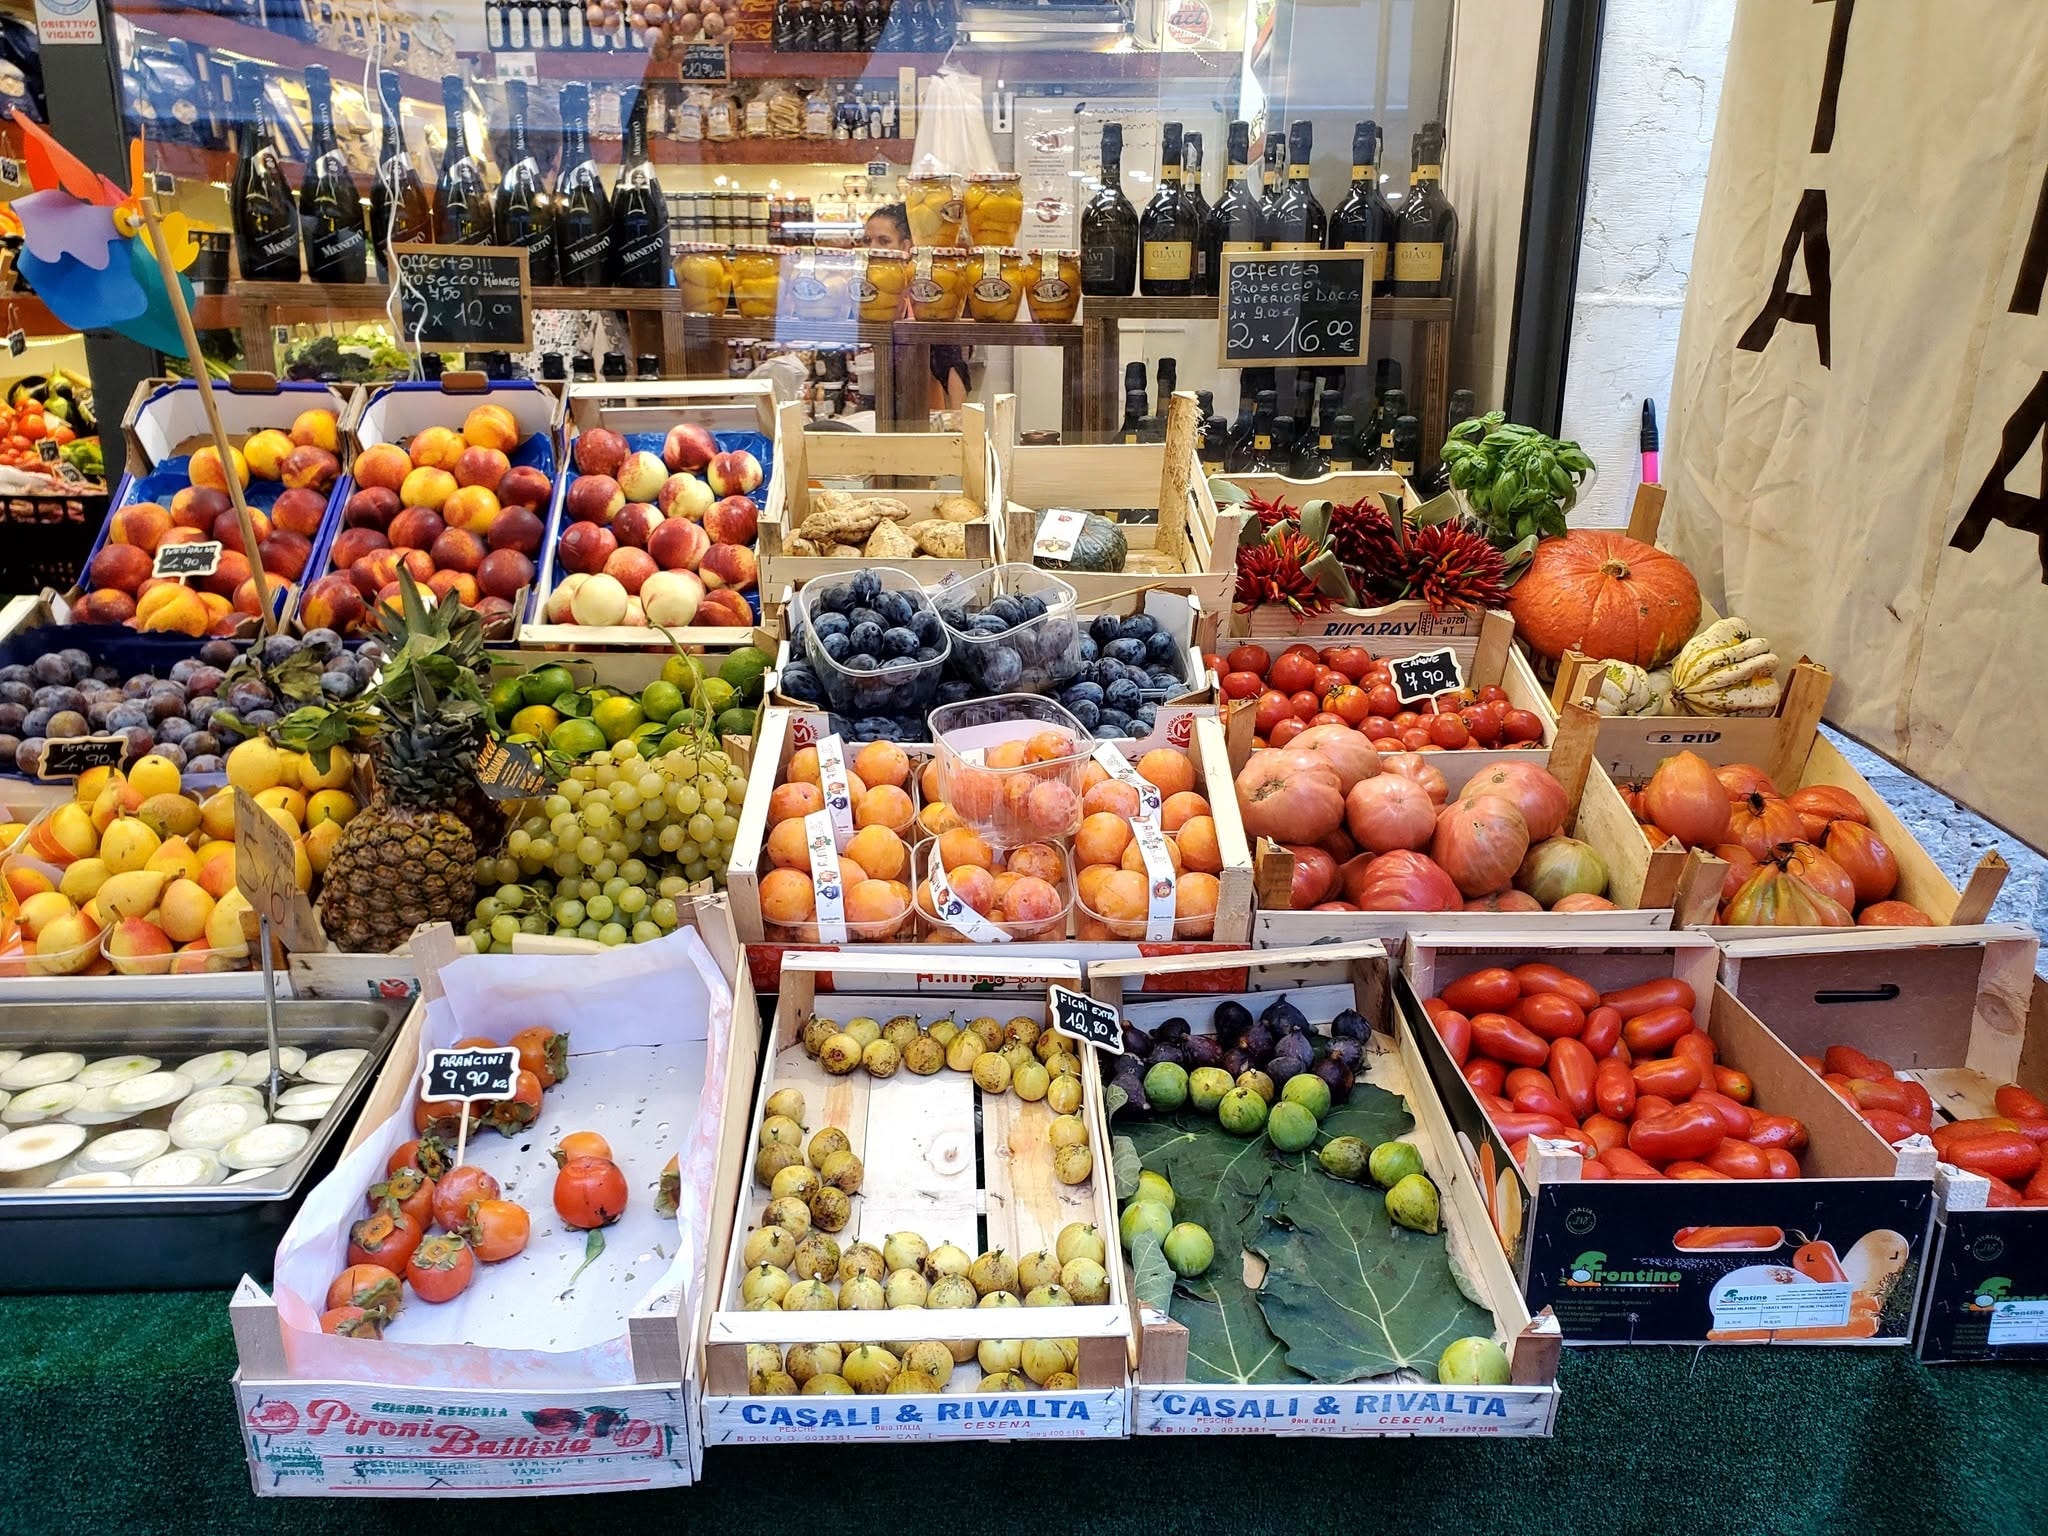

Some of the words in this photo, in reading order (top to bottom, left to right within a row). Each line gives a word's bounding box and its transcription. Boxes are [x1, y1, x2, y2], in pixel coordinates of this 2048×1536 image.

[41, 20, 97, 28] OBIETTIVO
[46, 31, 95, 39] VIGILATO
[262, 233, 298, 257] MIONET
[528, 233, 552, 254] NETTO
[569, 235, 612, 265] MIONETTO
[622, 236, 665, 266] MIONETTO
[1152, 250, 1183, 259] GIAVI
[1401, 250, 1432, 259] GIAVI
[1231, 263, 1319, 281] Offerta
[1230, 280, 1313, 295] PROSECCO
[1231, 292, 1310, 304] SUPERIORE
[1227, 322, 1254, 349] 2
[442, 1069, 490, 1092] 9,90
[742, 1404, 880, 1427] CASALI
[895, 1404, 923, 1423] &
[937, 1399, 1090, 1421] RIVALTA
[1162, 1394, 1298, 1418] CASALI
[1312, 1395, 1341, 1416] &
[1355, 1392, 1507, 1417] RIVALTA
[305, 1398, 435, 1437] Pironi
[963, 1421, 1031, 1430] CESENA
[1378, 1416, 1446, 1425] CESENA
[428, 1424, 592, 1457] Battista
